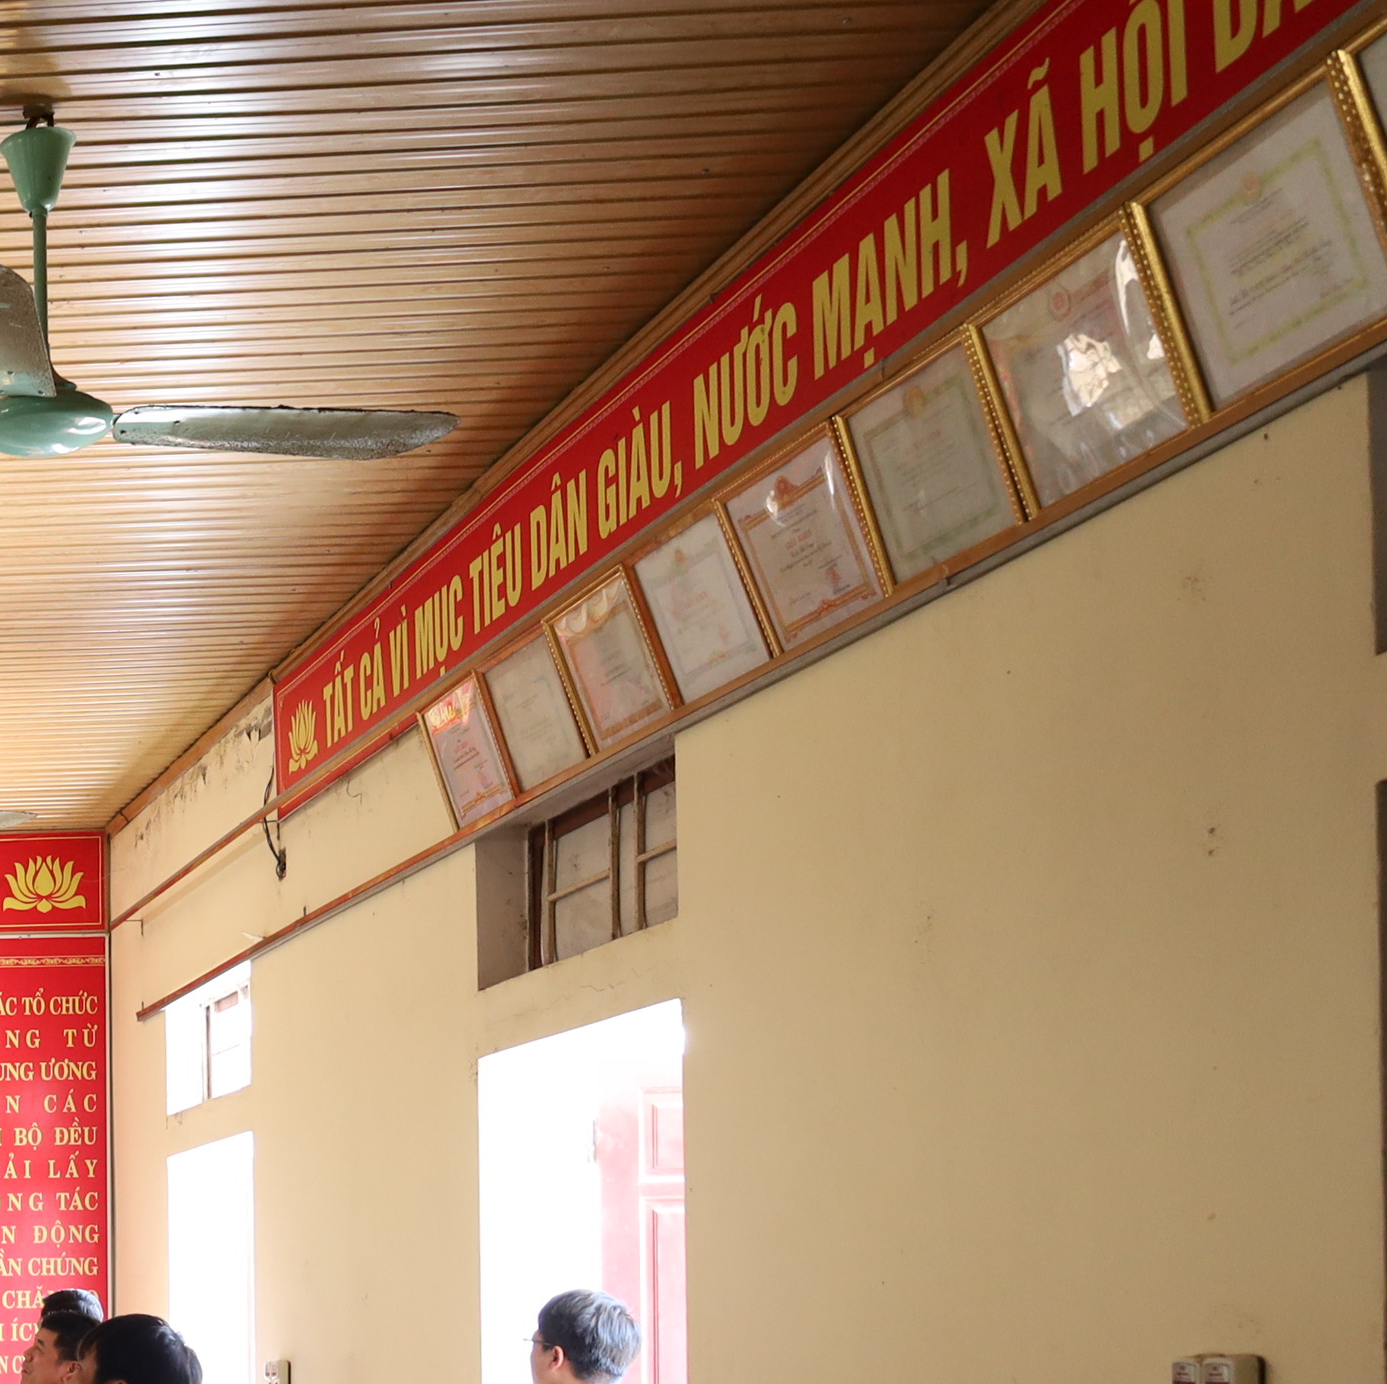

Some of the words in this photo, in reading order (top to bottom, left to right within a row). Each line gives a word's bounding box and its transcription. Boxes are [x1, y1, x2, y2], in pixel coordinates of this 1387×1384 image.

[323, 650, 354, 748] TẤT
[359, 617, 386, 721] CẢ
[389, 604, 410, 698] VÌ
[414, 574, 464, 680] MỤC
[469, 522, 523, 634] TIÊU
[530, 471, 588, 591] DÂN
[597, 400, 682, 540] GIÀU,
[693, 293, 798, 470] NƯỚC
[812, 168, 967, 381] MẠNH,
[984, 57, 1062, 249] XÃ
[1079, 0, 1187, 175] HỘI
[22, 988, 45, 1015] TỔ
[50, 991, 97, 1015] CHỨC
[64, 1023, 98, 1047] TỪ
[40, 1058, 97, 1081] ƯƠNG
[42, 1089, 96, 1113] CÁC
[14, 1122, 42, 1150] BỘ
[54, 1117, 97, 1145] ĐỀU
[48, 1151, 98, 1178] LẤY
[56, 1187, 98, 1211] TÁC
[33, 1220, 99, 1248] ĐỘNG
[27, 1252, 98, 1276] CHÚNG
[2, 1285, 53, 1309] CHĂ
